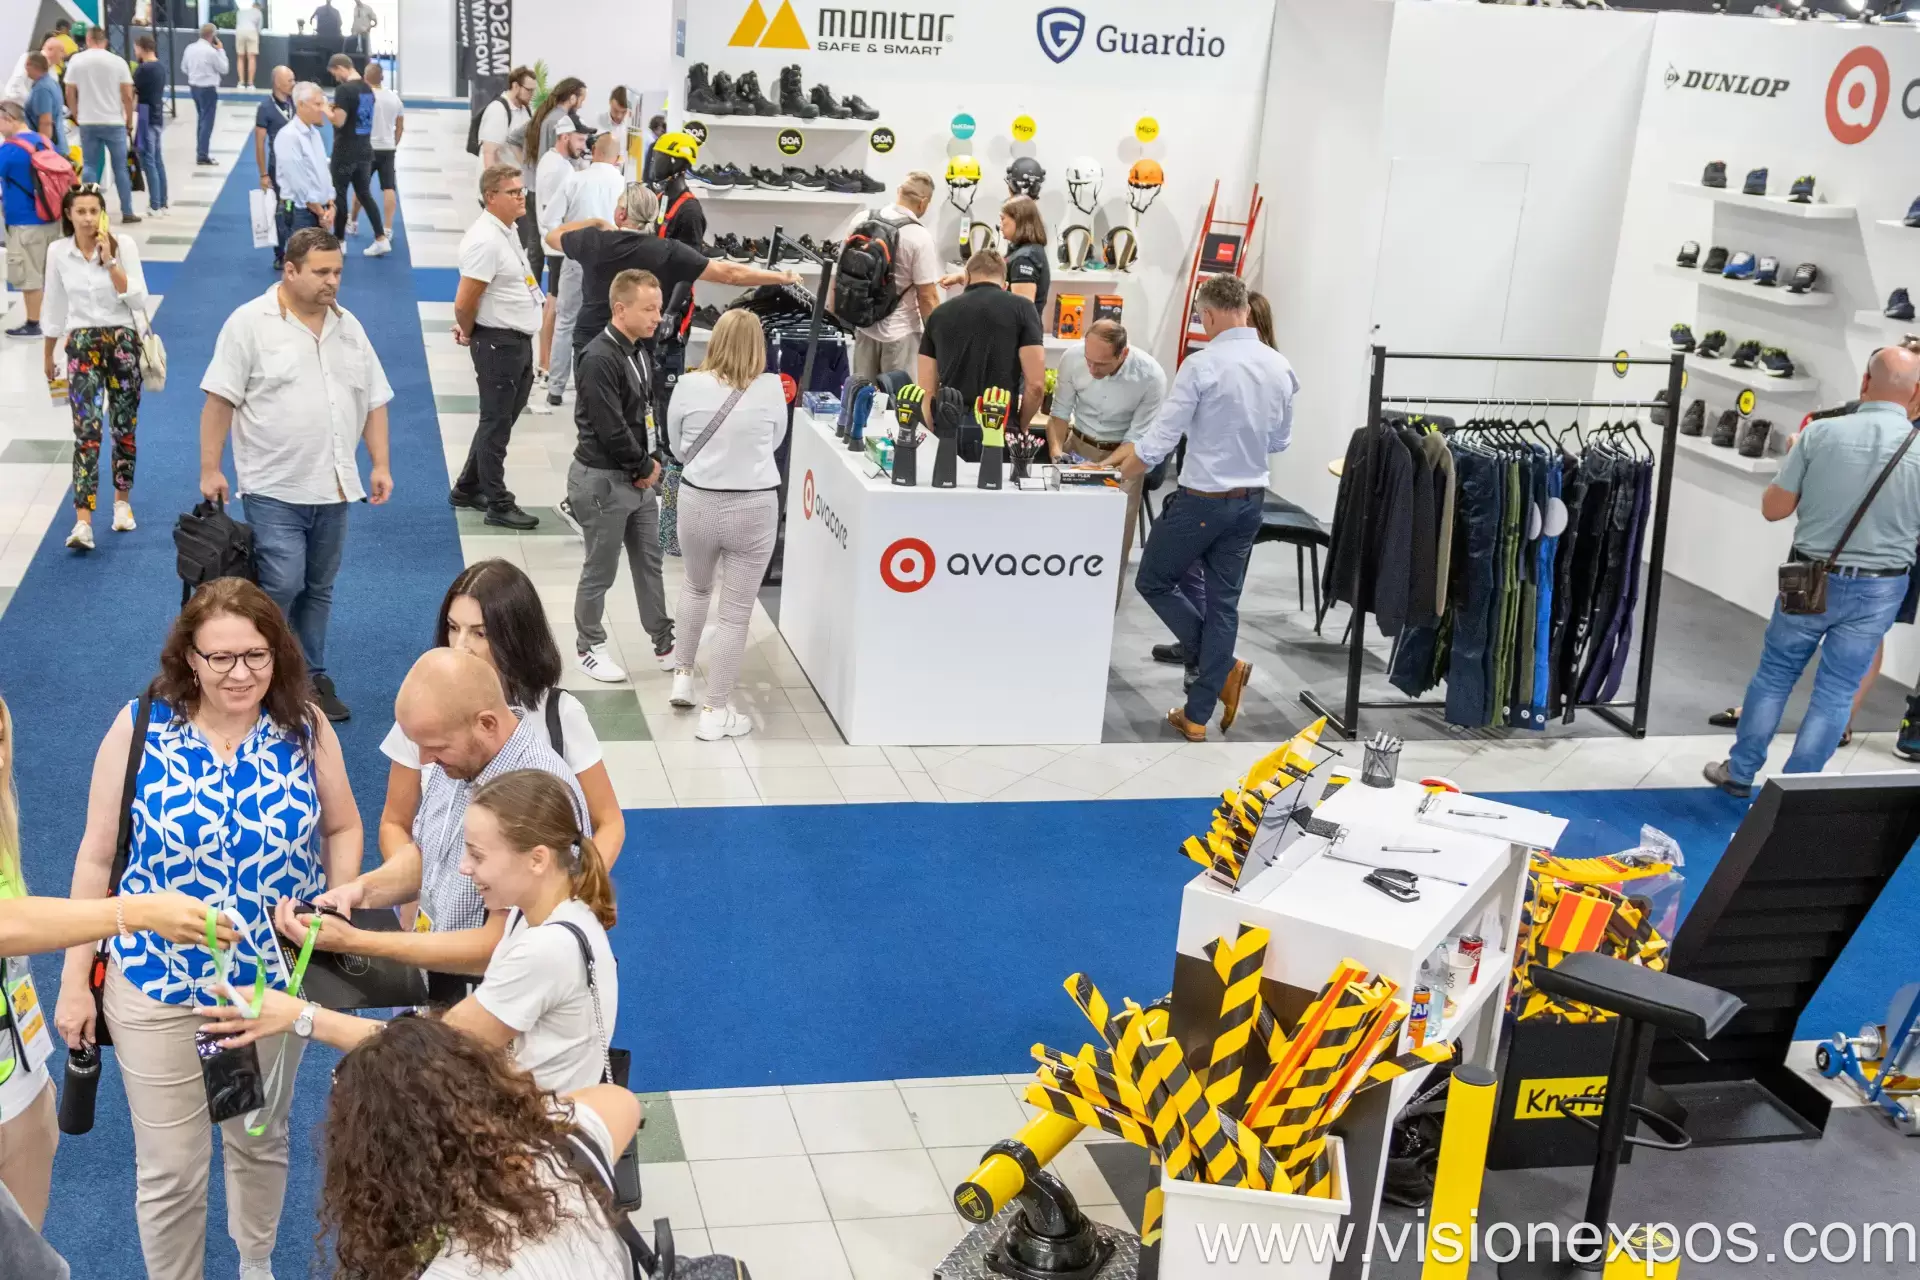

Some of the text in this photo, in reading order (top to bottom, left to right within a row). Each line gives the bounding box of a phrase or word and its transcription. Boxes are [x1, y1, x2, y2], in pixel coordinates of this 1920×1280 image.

[817, 41, 942, 56] SAFE & SMART
[1096, 24, 1225, 57] Guardio
[1683, 70, 1790, 98] DUNLOP
[1014, 123, 1033, 132] Mips
[1138, 126, 1156, 134] Mips
[815, 494, 848, 550] avacore
[947, 553, 1104, 577] avacore
